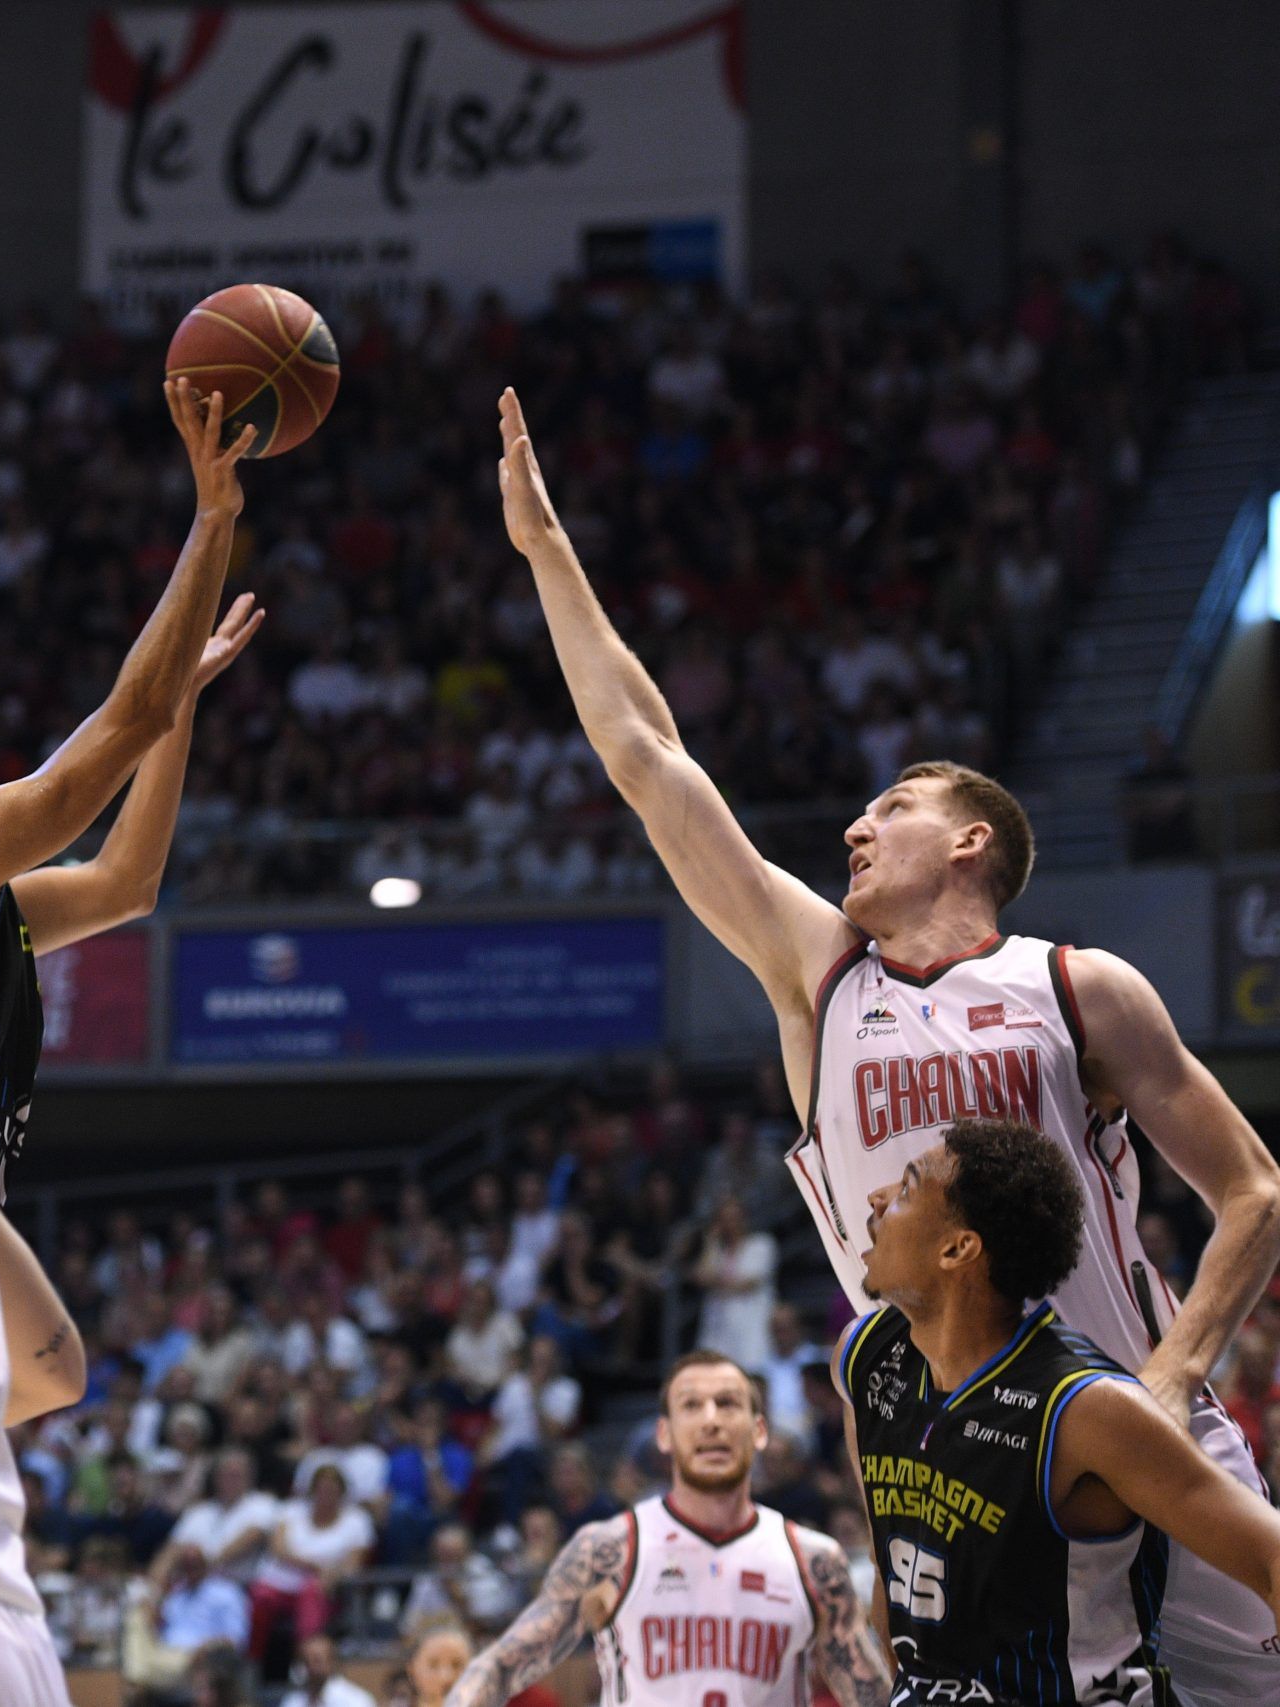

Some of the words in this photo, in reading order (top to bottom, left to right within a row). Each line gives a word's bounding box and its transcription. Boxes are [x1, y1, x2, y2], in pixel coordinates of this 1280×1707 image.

[227, 35, 588, 212] Colisée
[870, 1026, 899, 1038] Sports
[853, 1046, 1044, 1151] CHALON
[873, 1488, 965, 1543] BASKET
[886, 1535, 948, 1624] 95
[641, 1615, 792, 1686] CHALON
